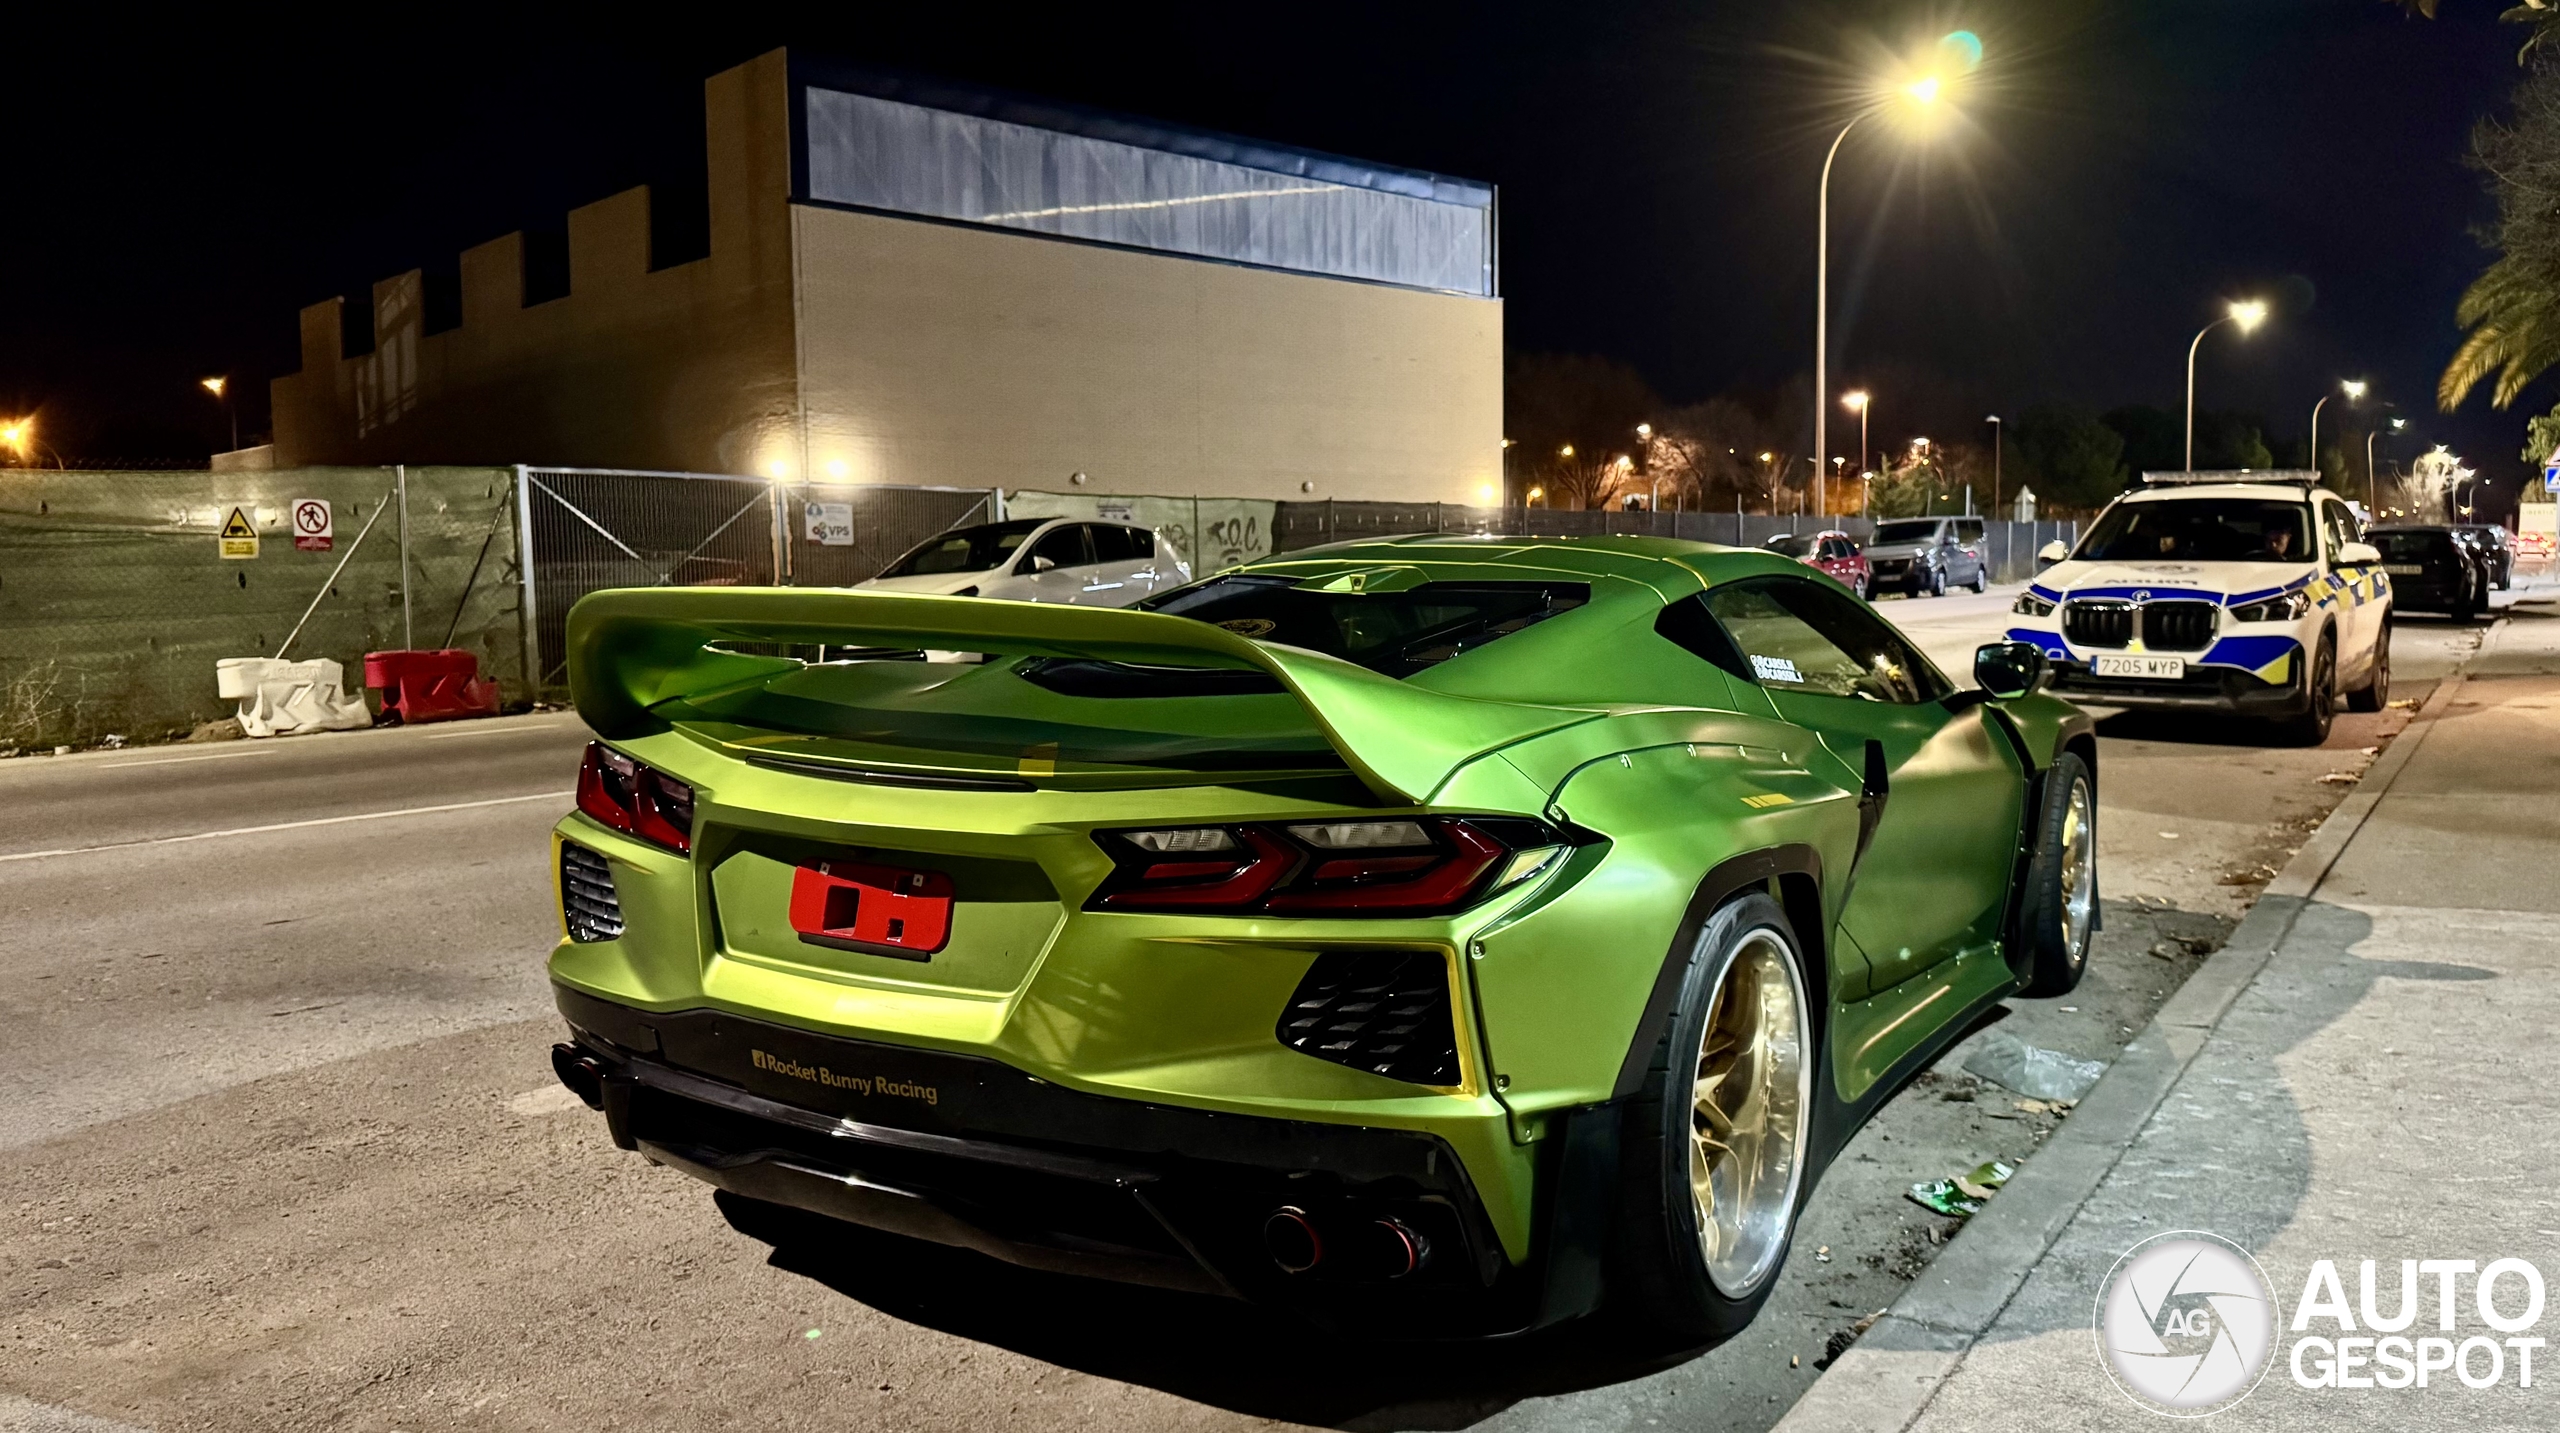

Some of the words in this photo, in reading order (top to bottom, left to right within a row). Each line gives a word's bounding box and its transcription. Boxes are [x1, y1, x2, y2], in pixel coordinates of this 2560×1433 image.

[828, 525, 850, 536] VPS
[2101, 659, 2142, 674] 7205
[2148, 660, 2179, 675] MYP
[767, 1053, 817, 1082] Rocket
[819, 1067, 872, 1096] Bunny
[875, 1076, 938, 1105] Racing
